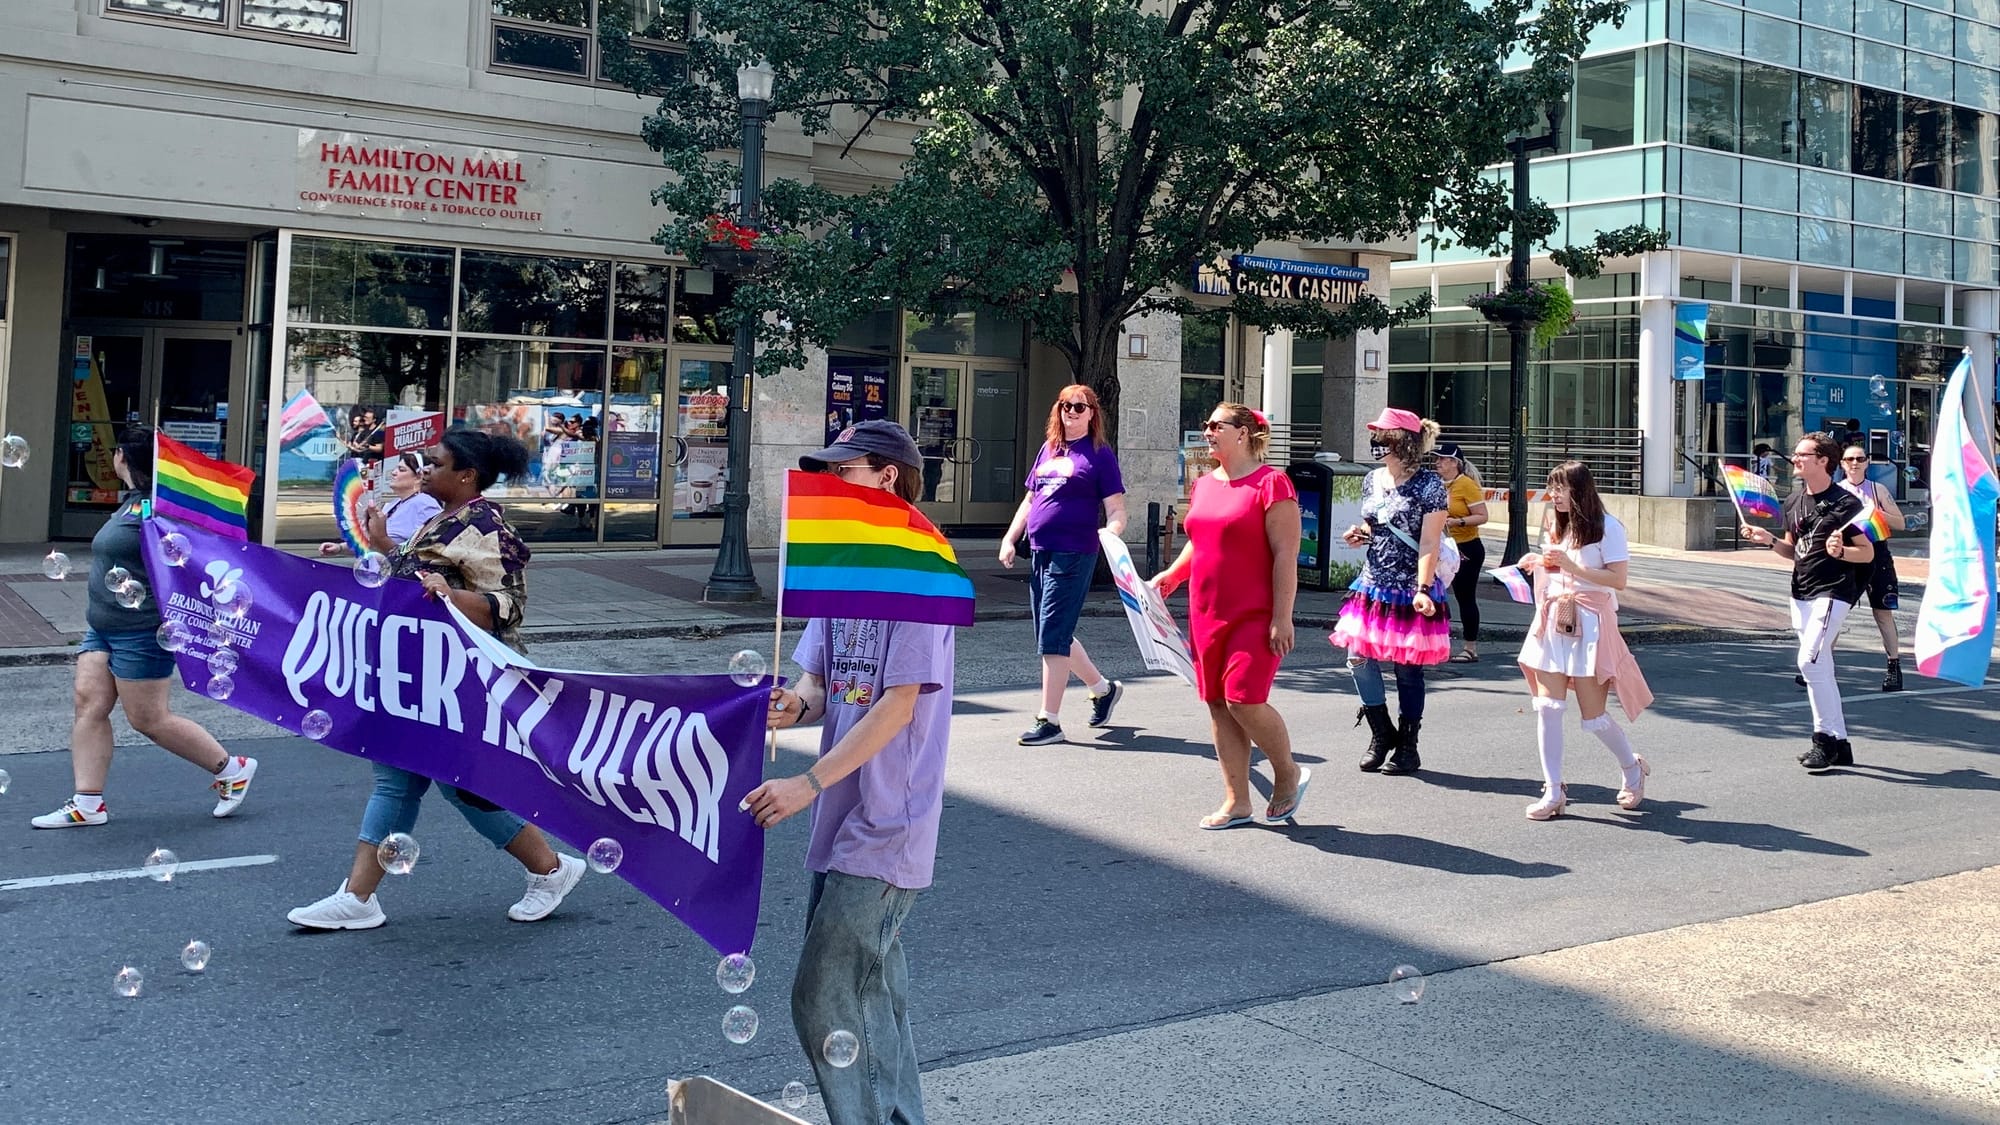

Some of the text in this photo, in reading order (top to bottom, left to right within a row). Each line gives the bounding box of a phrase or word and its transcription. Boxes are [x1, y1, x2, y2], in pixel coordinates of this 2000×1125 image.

[320, 142, 527, 183] HAMILTON MALL
[328, 168, 518, 206] FAMILY CENTER
[300, 191, 543, 221] CONVENIENCE STORE & TOBACCO OUTLET
[1242, 256, 1367, 280] Family Financial Centers
[1299, 276, 1369, 304] CASHING
[978, 386, 999, 394] metro
[1829, 387, 1844, 403] Hi!
[394, 429, 428, 450] QUALITY
[607, 487, 624, 495] Lyca
[164, 609, 188, 623] LGBT
[282, 590, 468, 734] QUEER
[568, 688, 730, 865] YEAR
